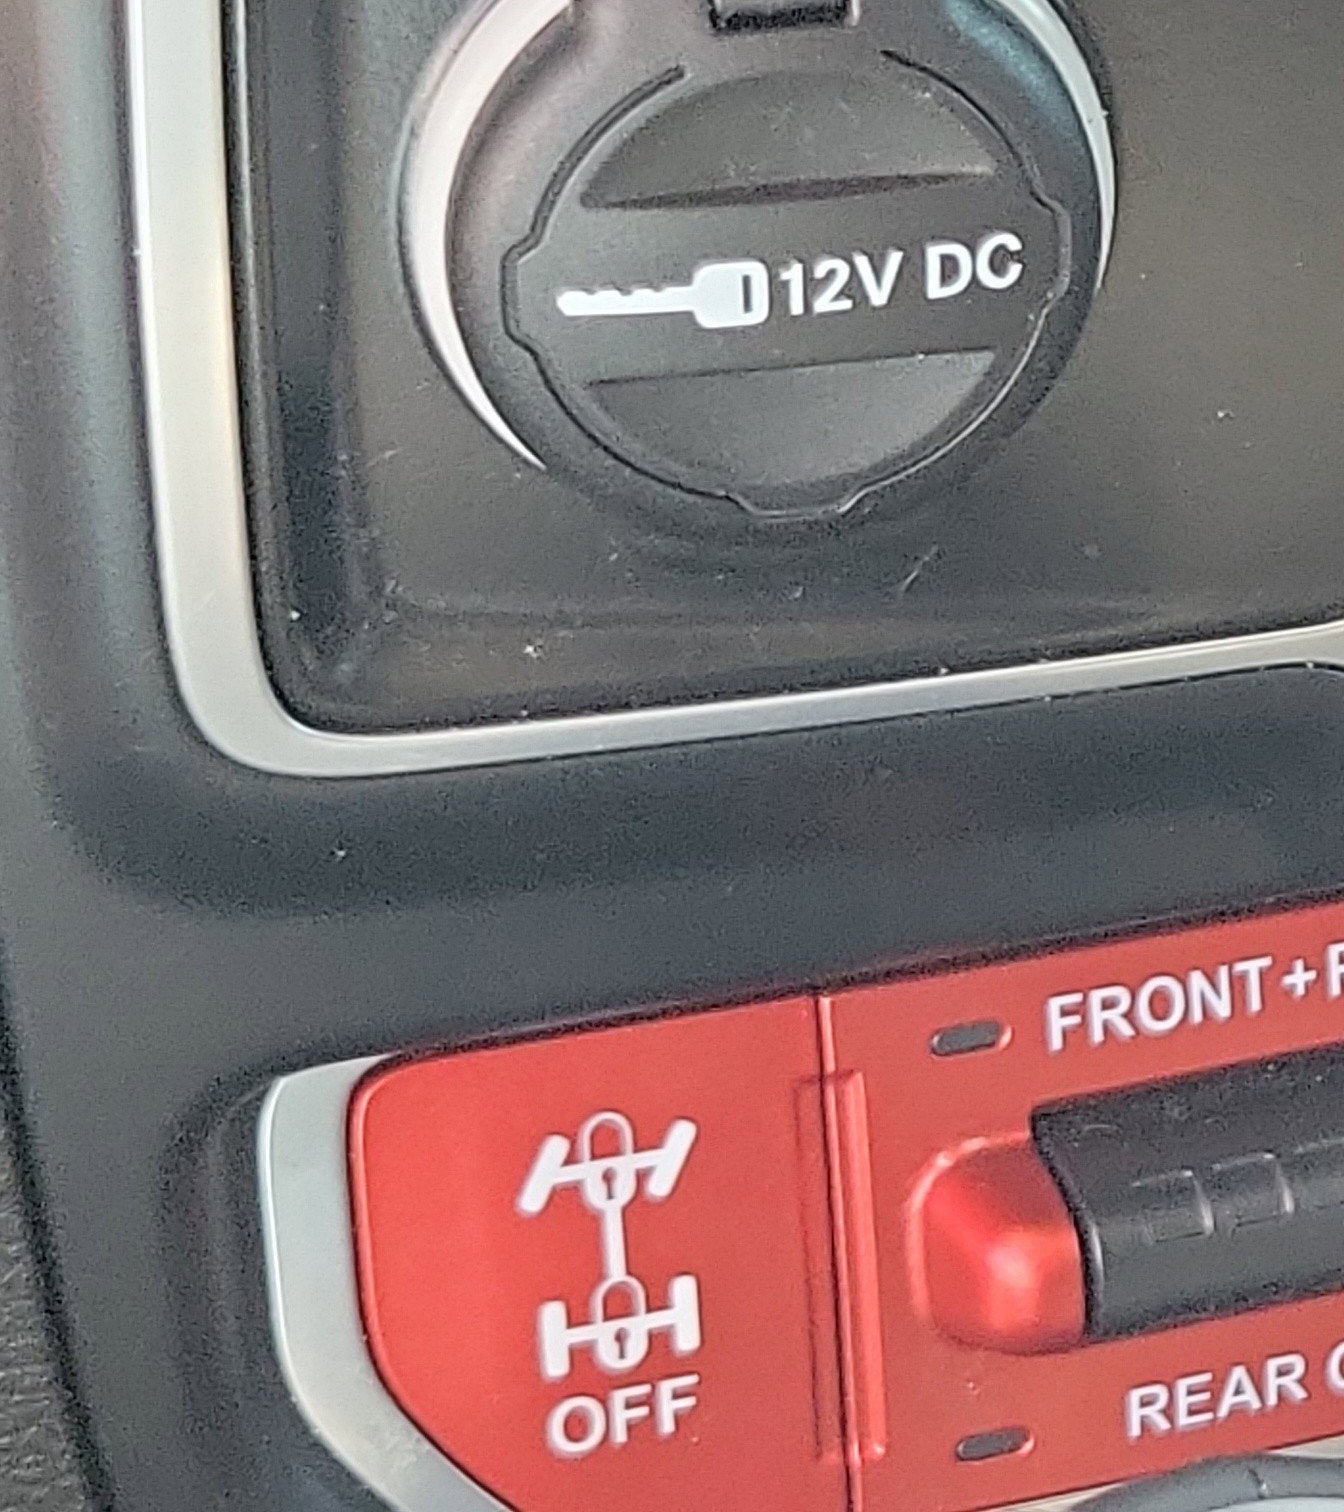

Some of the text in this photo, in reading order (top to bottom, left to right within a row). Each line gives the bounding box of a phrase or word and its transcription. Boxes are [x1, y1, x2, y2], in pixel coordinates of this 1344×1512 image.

[778, 231, 1024, 317] 12V DC
[542, 1371, 700, 1458] OFF
[1126, 1353, 1308, 1439] REAR
